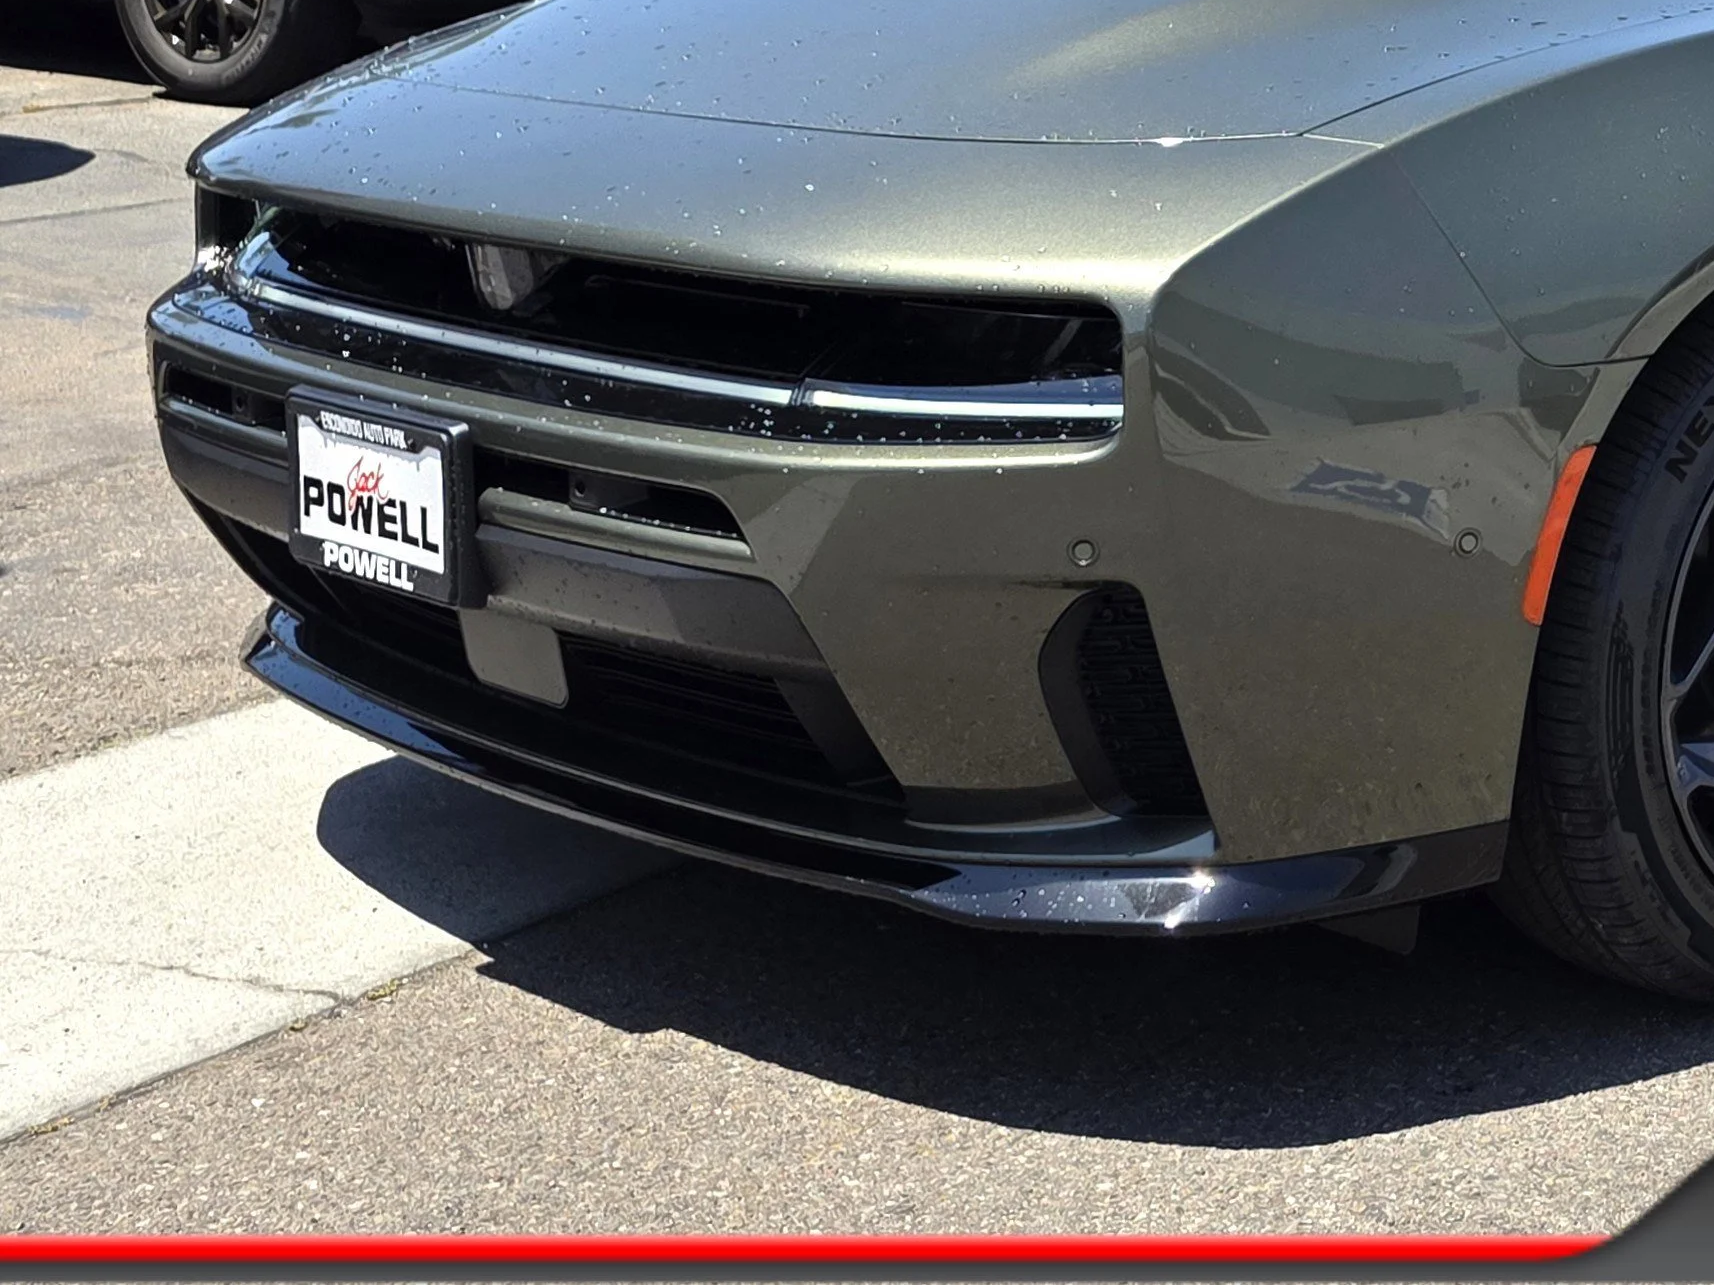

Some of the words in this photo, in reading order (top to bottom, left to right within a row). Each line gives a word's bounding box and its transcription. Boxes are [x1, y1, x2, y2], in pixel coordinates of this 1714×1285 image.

[383, 426, 408, 450] PARK
[346, 456, 390, 512] Jack
[303, 475, 440, 555] POWELL
[322, 540, 415, 592] POWELL
